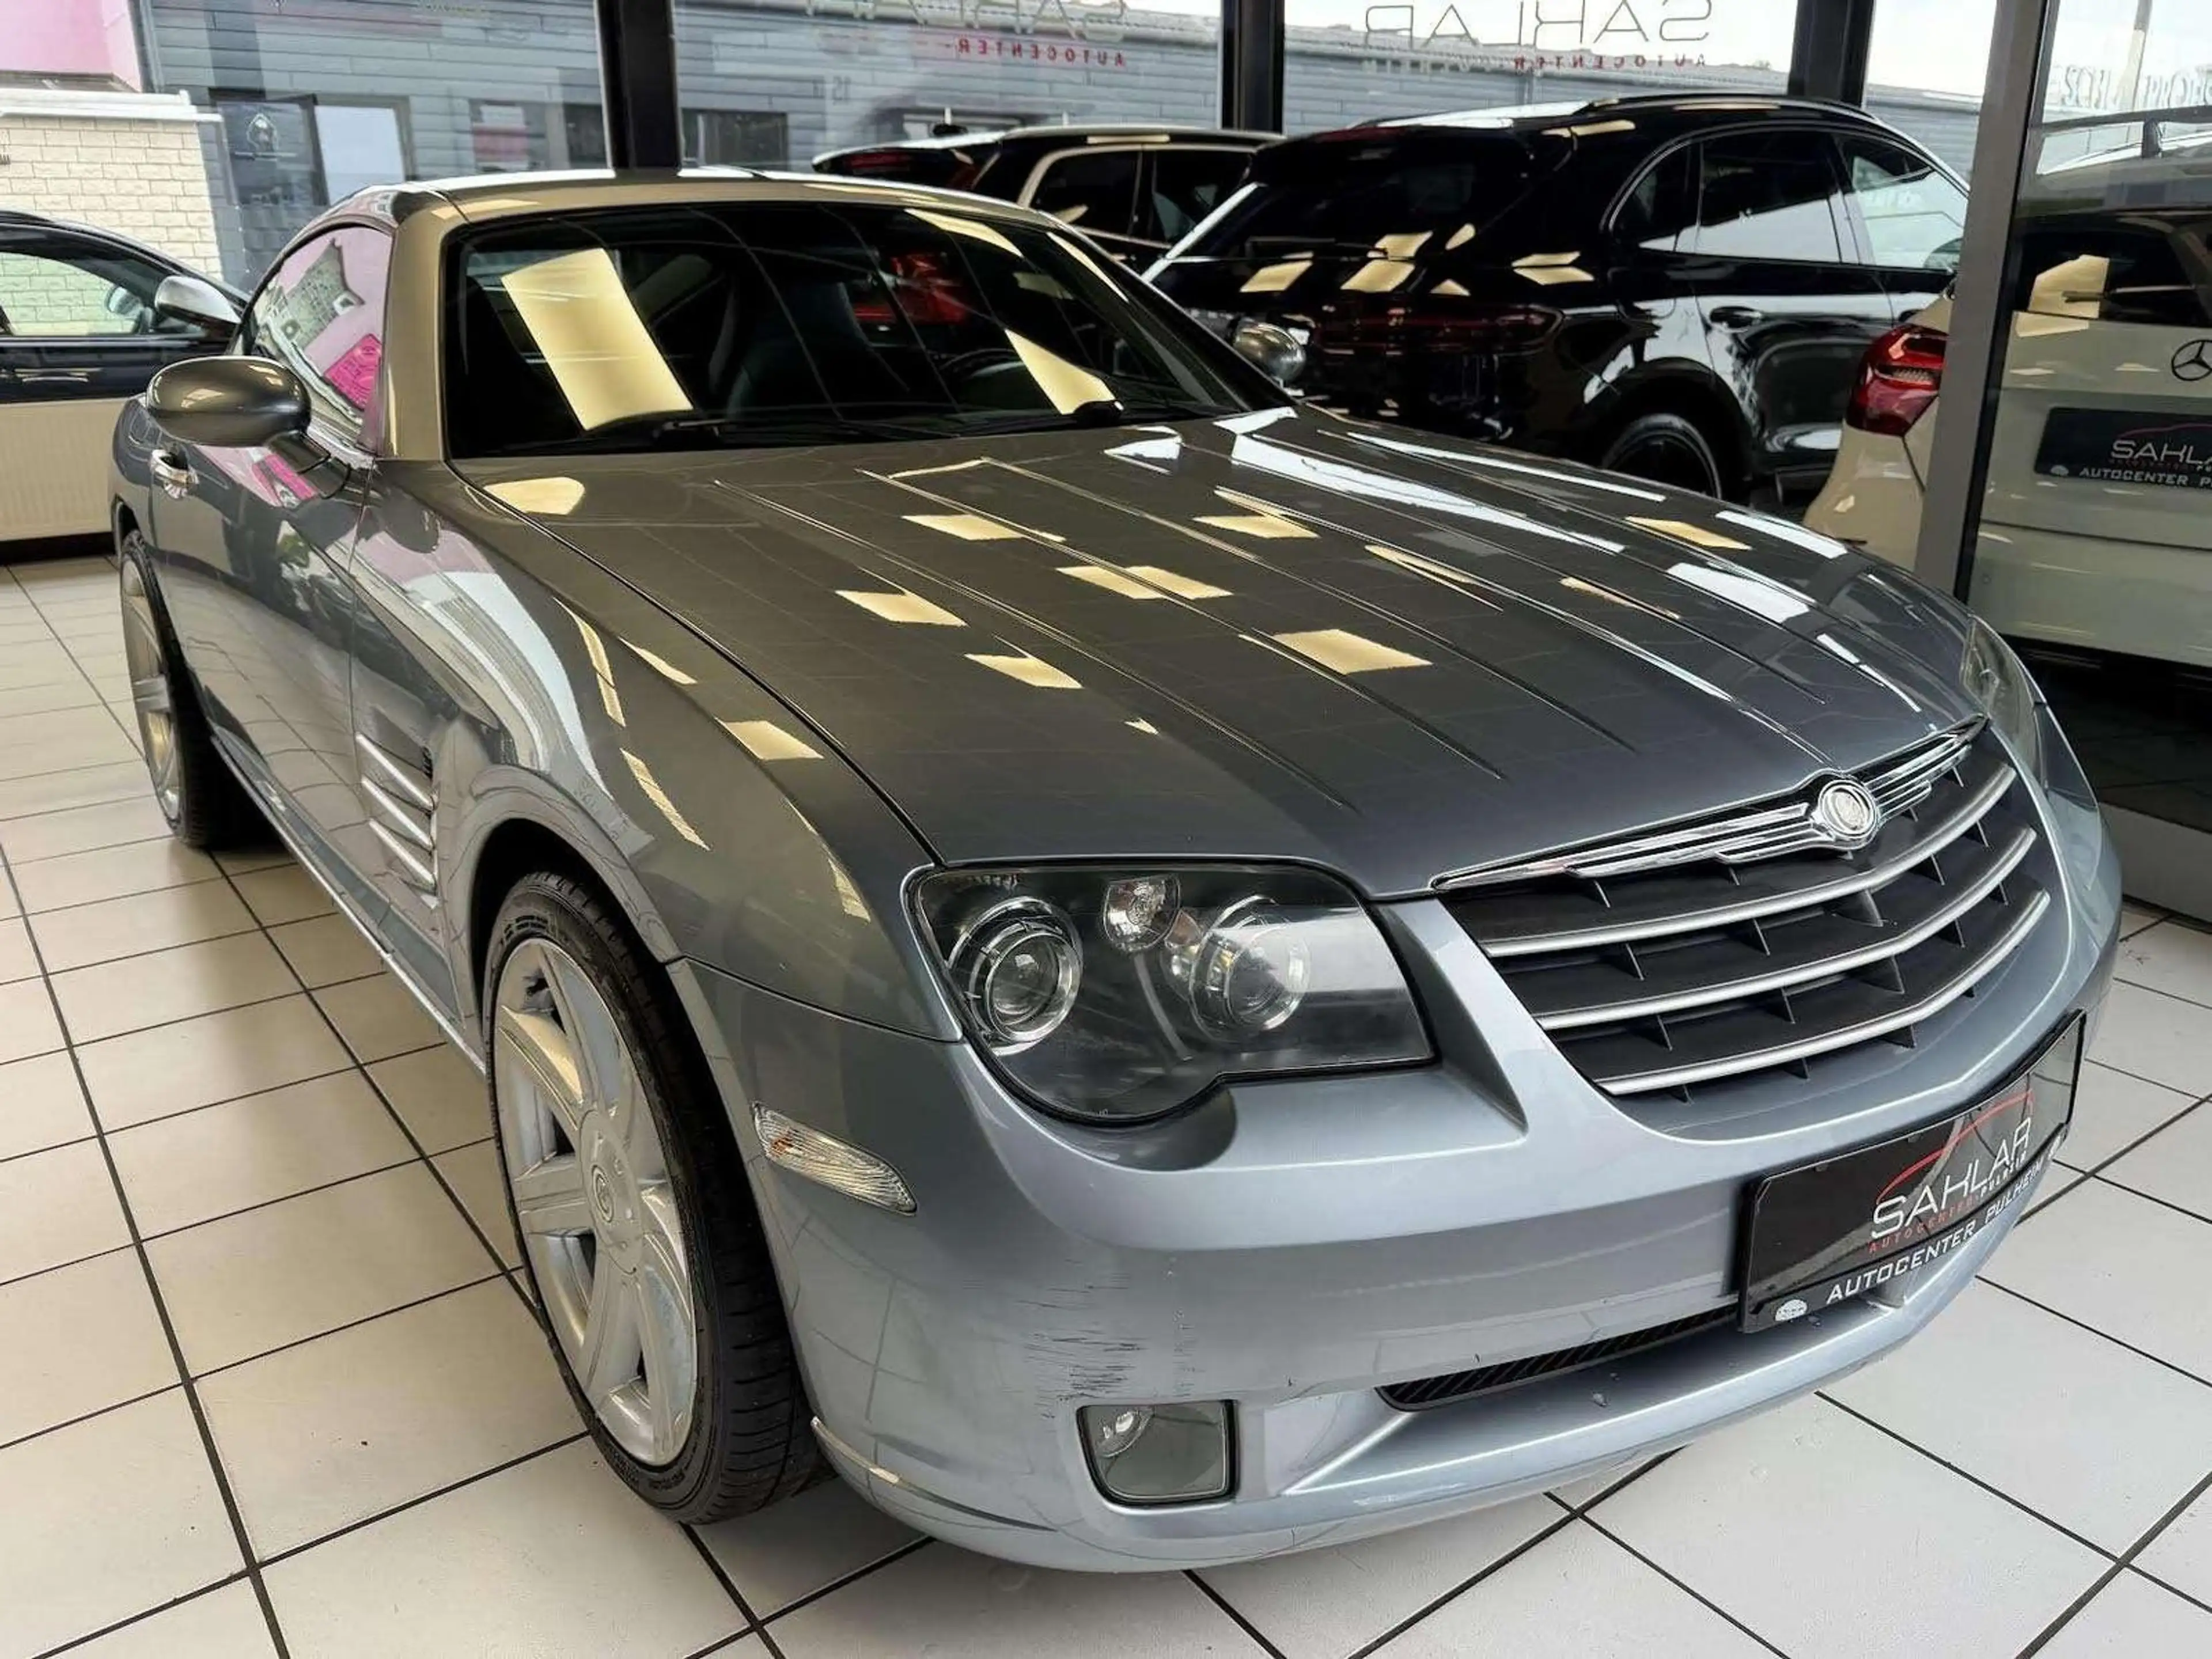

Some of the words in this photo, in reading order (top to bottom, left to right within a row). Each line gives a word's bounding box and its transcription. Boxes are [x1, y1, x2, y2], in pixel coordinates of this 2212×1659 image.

[2079, 467, 2189, 486] AUTOCENTER
[1872, 1116, 2031, 1238] SAHLAR
[1827, 1219, 1977, 1305] AUTOCENTER
